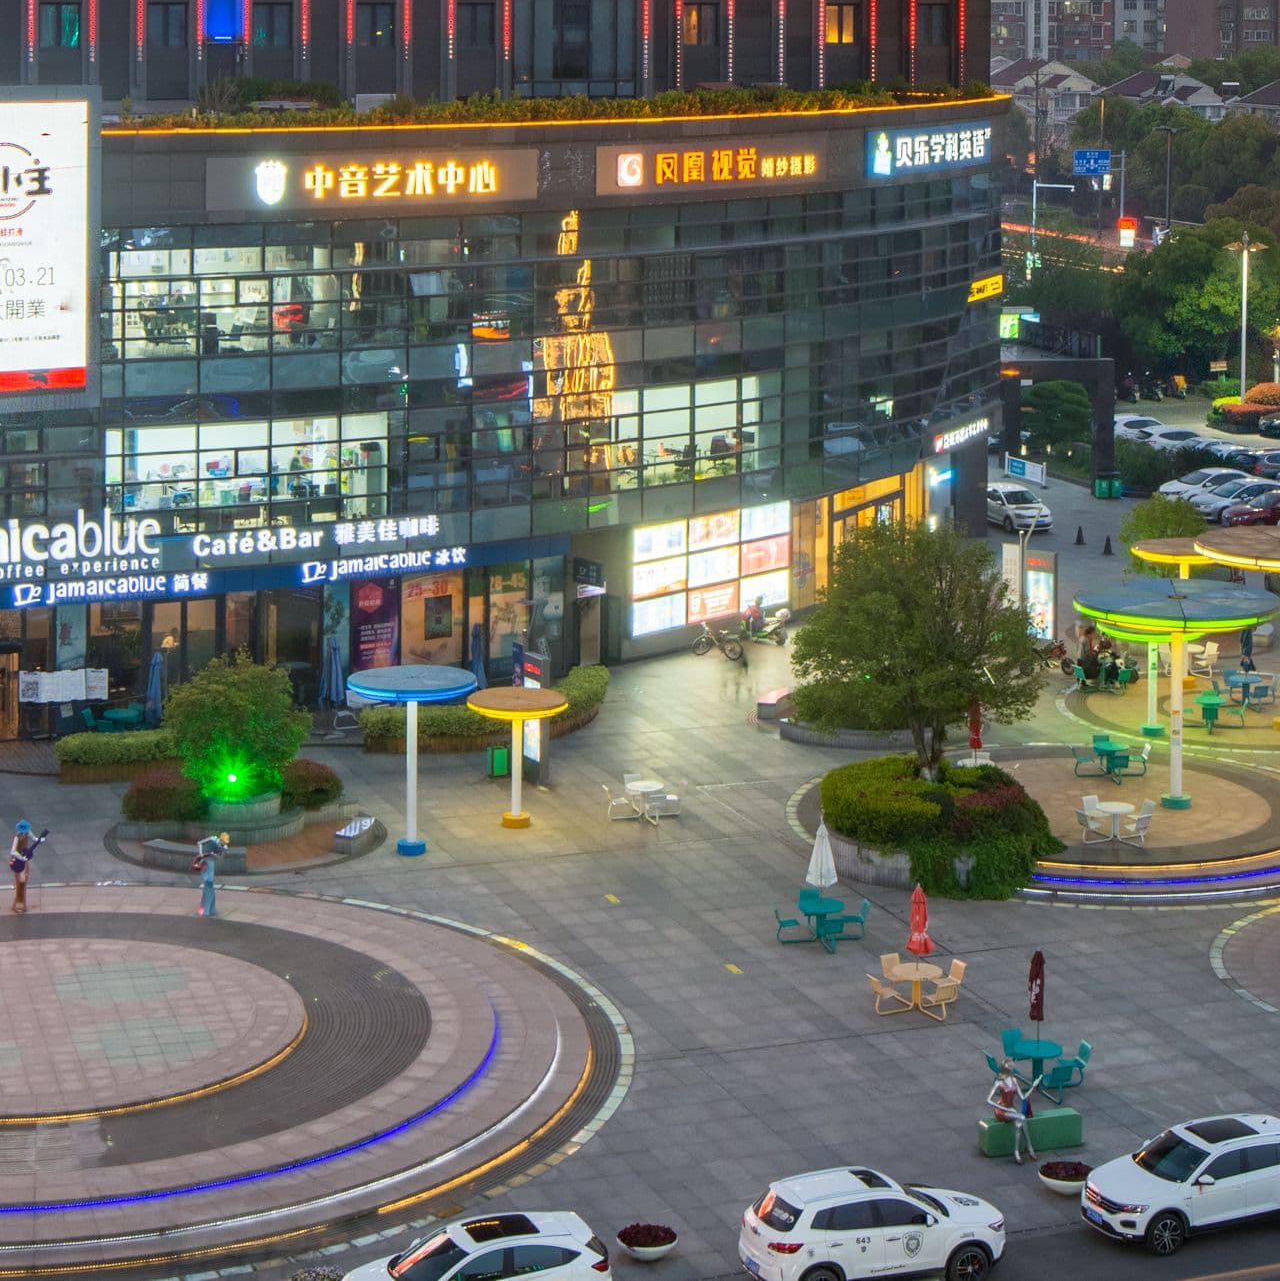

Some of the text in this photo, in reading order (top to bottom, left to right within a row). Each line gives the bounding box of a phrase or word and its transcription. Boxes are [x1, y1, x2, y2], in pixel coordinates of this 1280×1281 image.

[895, 129, 985, 168] 贝乐学科英语
[305, 161, 497, 199] 中音艺术中心
[334, 514, 440, 546] 雅美佳咖啡
[60, 557, 161, 575] experience
[173, 572, 209, 593] 简餐
